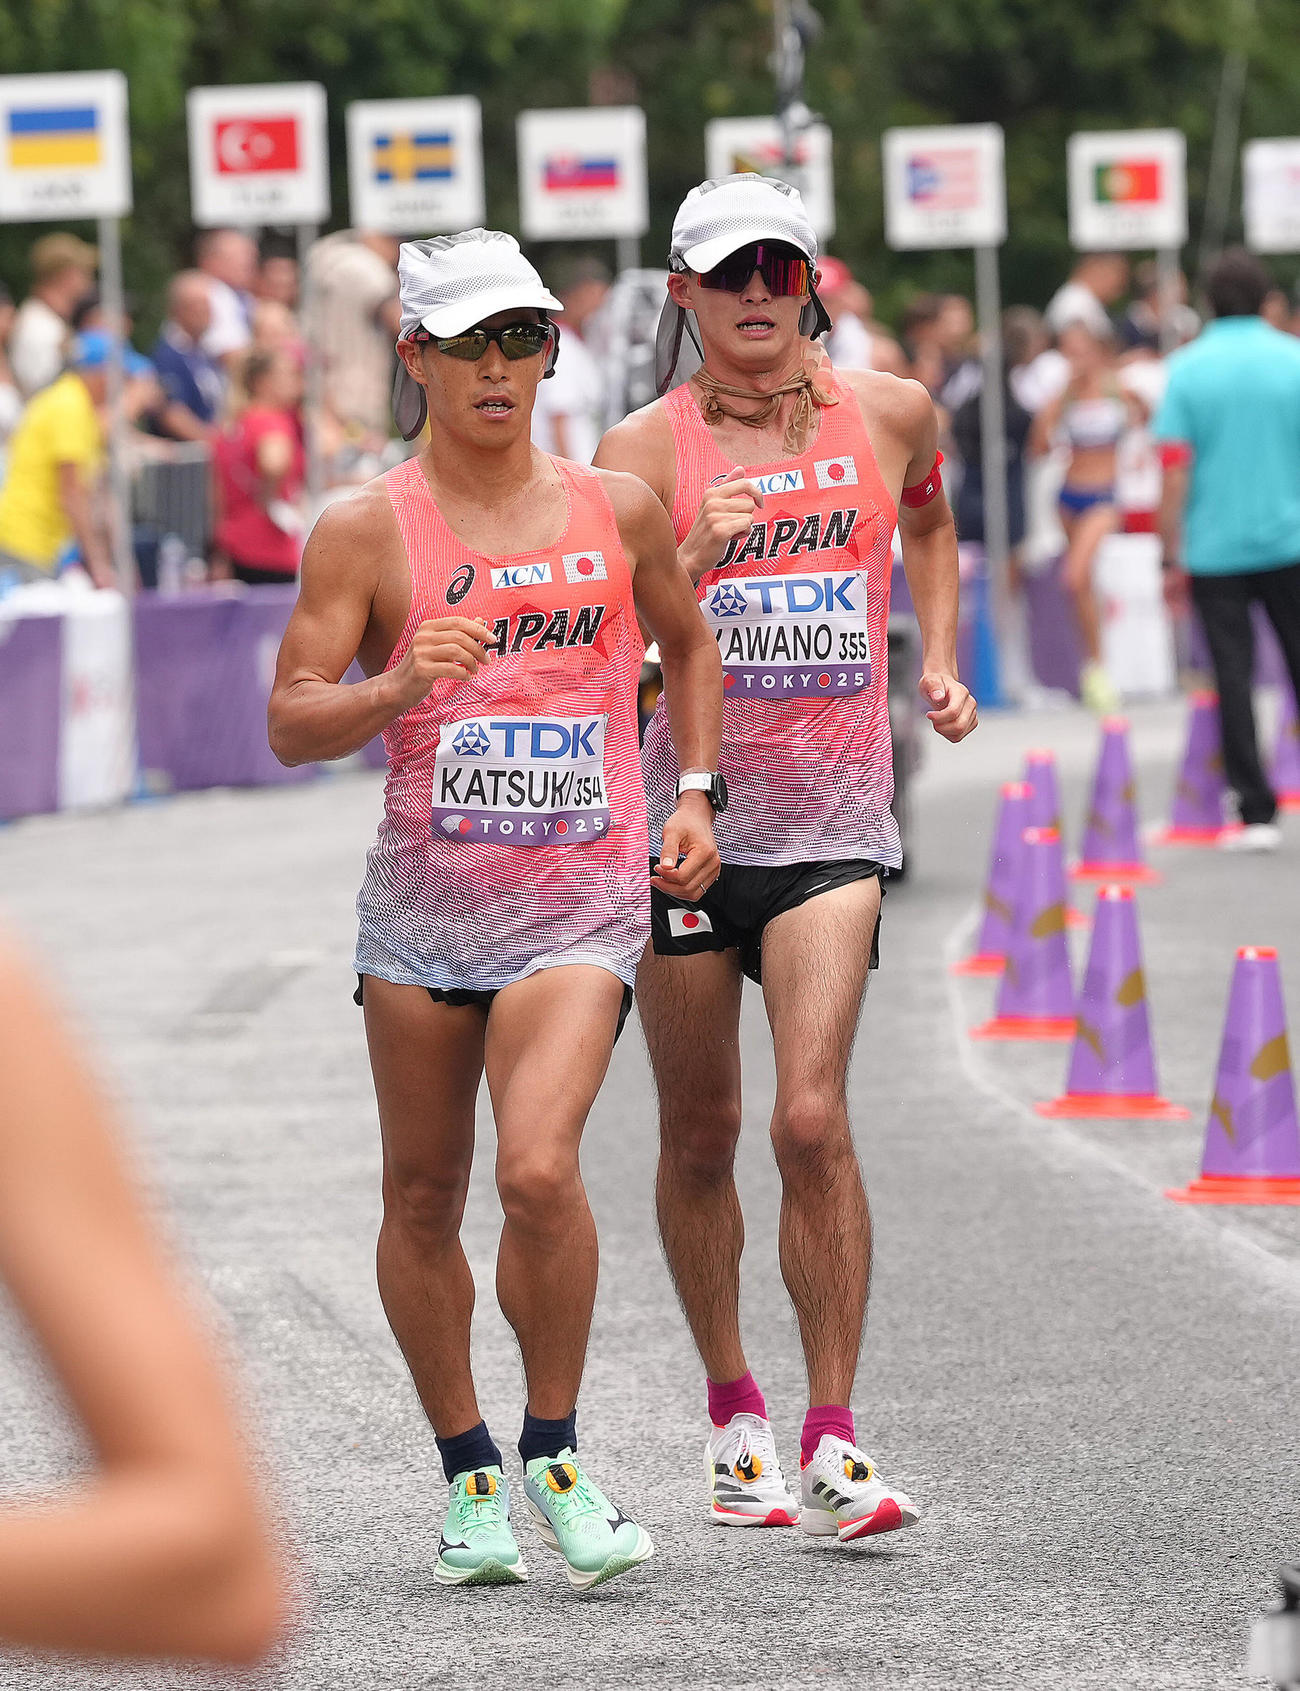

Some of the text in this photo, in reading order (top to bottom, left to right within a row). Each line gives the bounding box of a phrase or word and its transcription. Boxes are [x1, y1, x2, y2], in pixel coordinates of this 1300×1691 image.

[495, 564, 548, 588] ACN
[745, 576, 857, 614] TDK
[478, 604, 607, 658] APAN
[838, 631, 868, 661] 355
[490, 720, 600, 760] TDK
[440, 767, 603, 808] KATSUKI 354
